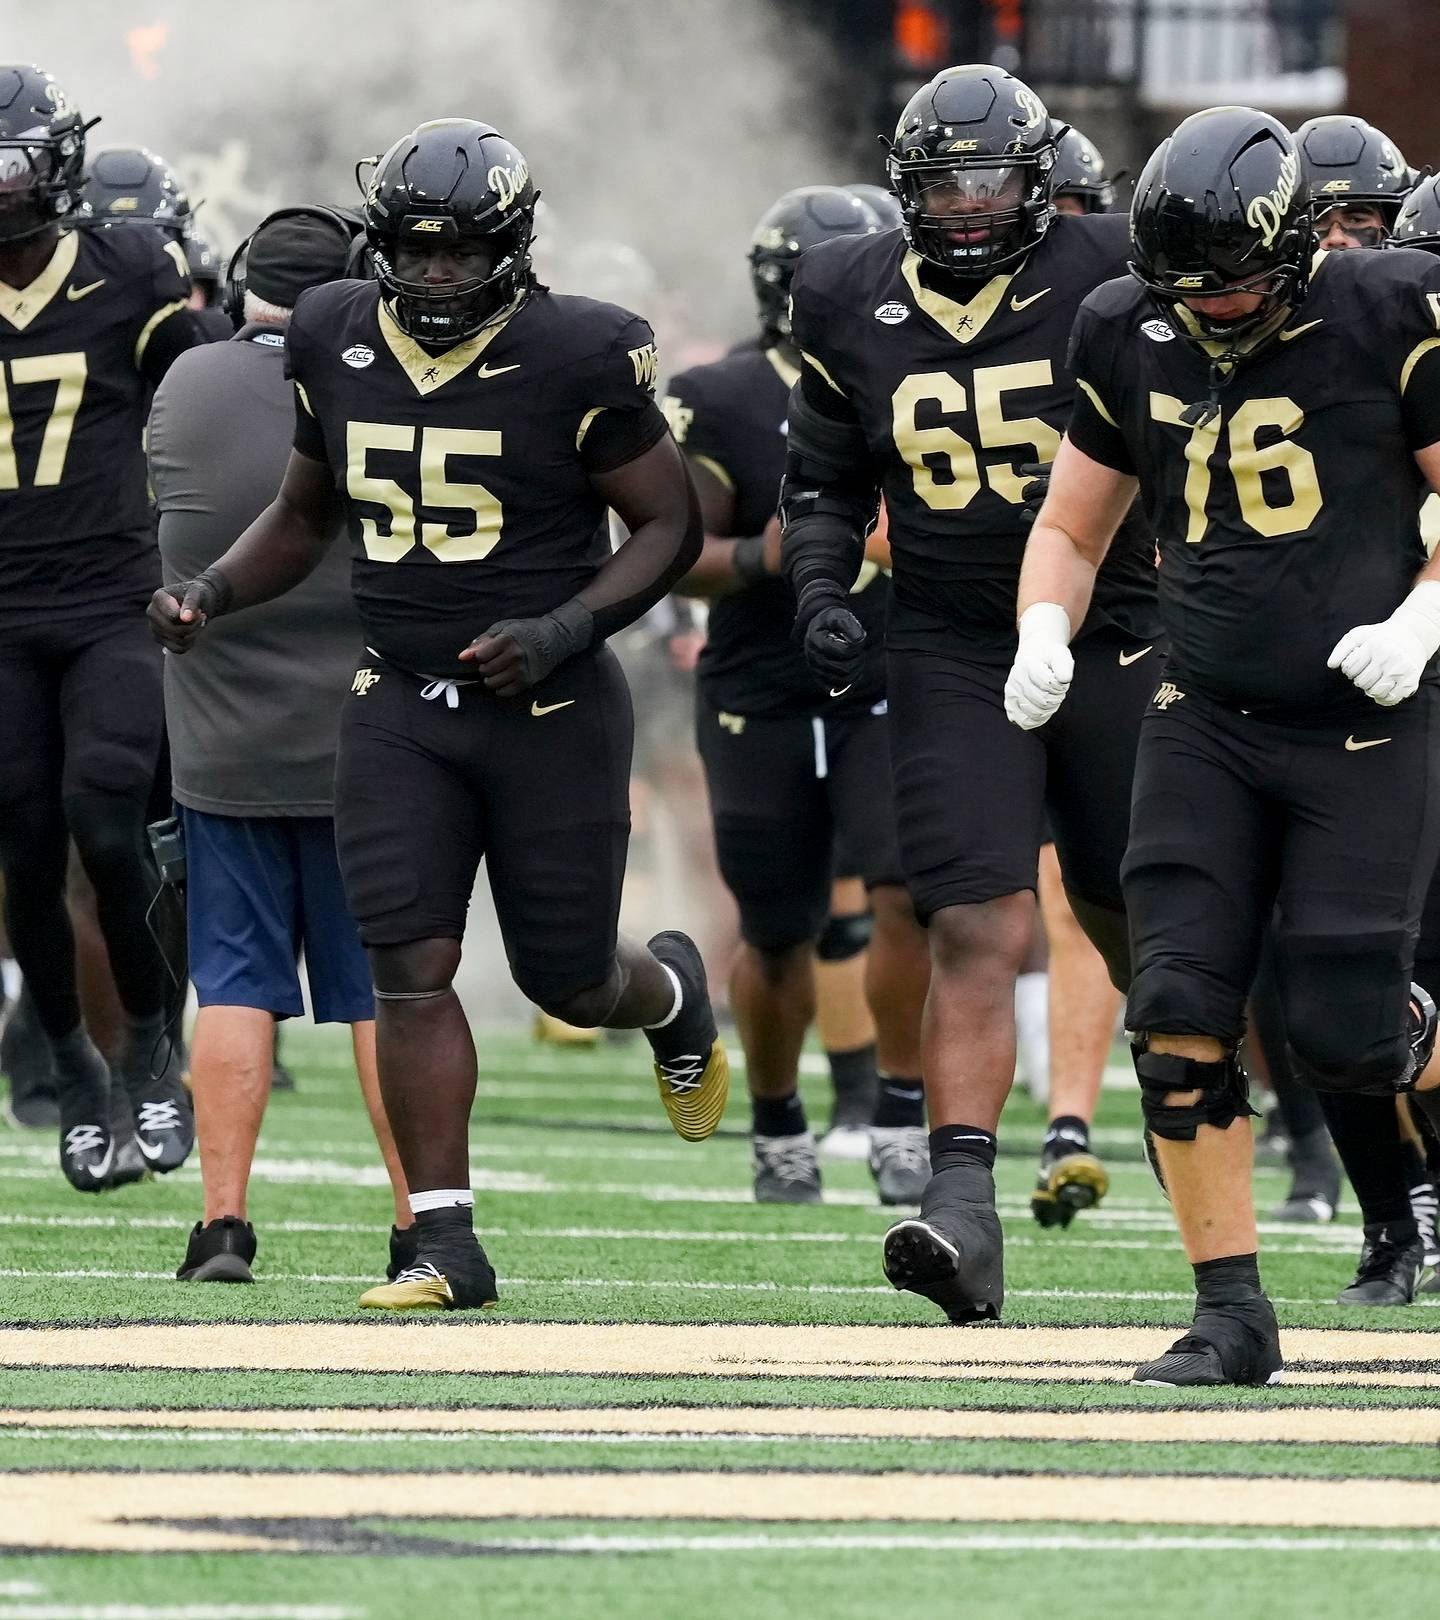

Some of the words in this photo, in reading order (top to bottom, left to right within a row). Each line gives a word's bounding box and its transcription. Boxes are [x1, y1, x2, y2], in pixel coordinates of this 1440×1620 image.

[940, 138, 981, 153] ACC
[410, 219, 445, 232] ACC
[1172, 275, 1205, 288] ACC
[891, 359, 1064, 510] 65
[1149, 391, 1324, 543] 76
[346, 420, 503, 563] 55
[350, 668, 381, 696] WF
[1152, 681, 1186, 710] WF
